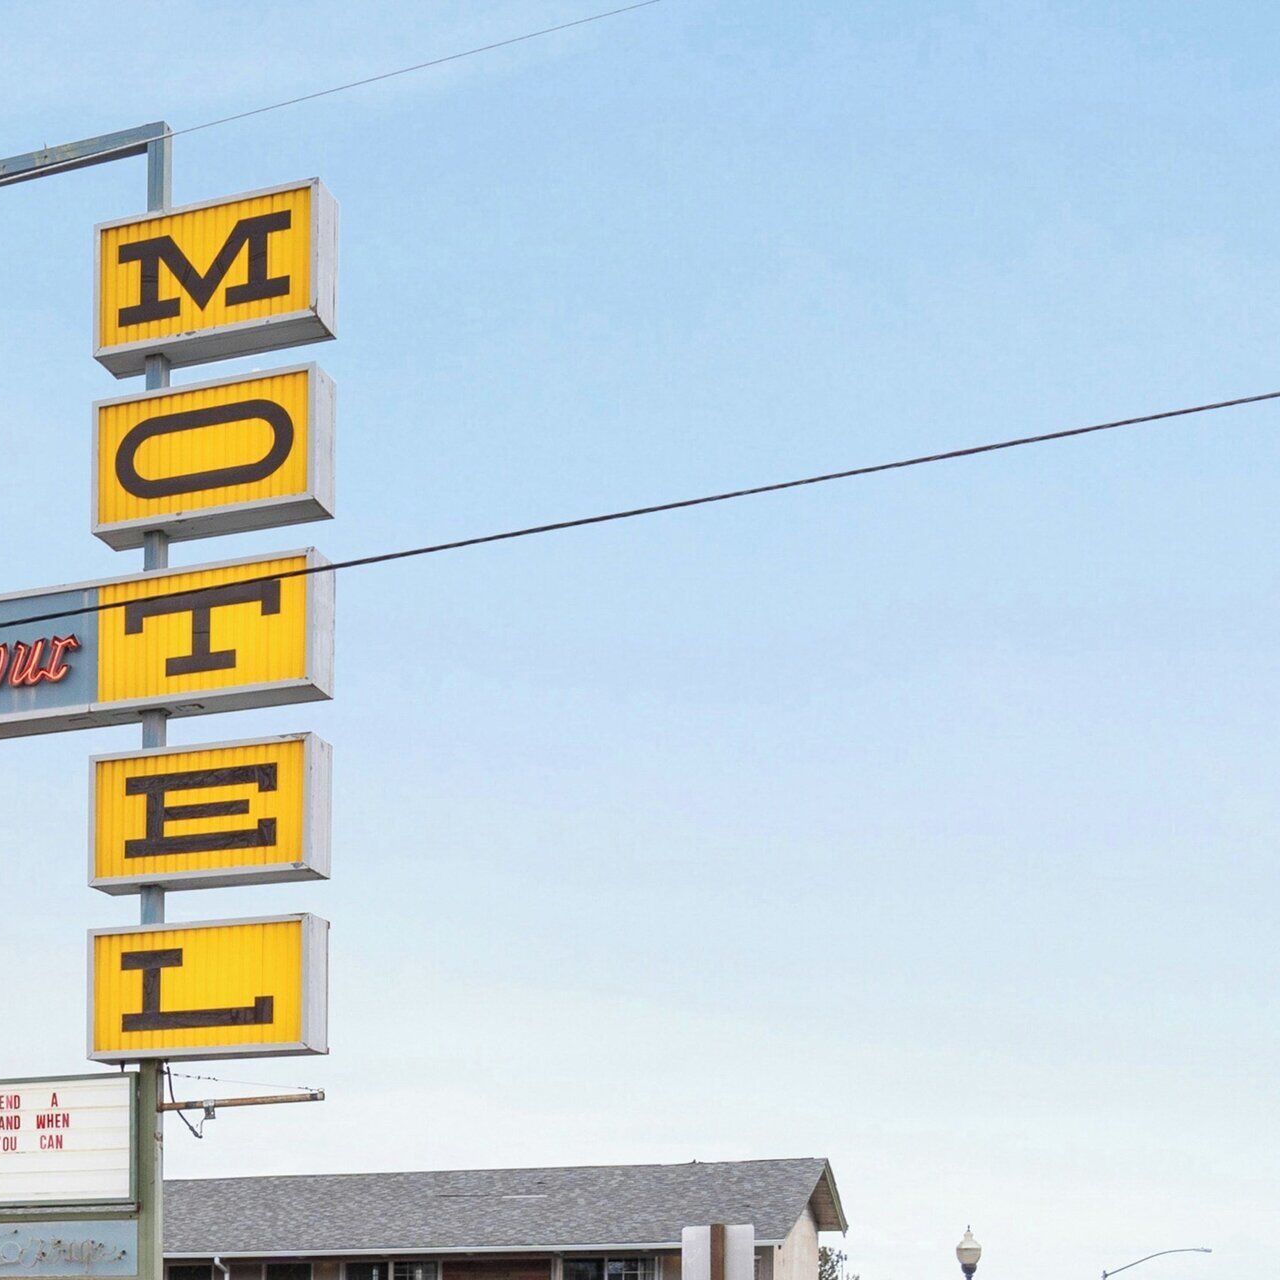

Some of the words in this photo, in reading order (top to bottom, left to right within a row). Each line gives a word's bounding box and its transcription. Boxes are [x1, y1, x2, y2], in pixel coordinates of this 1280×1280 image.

[114, 210, 294, 1033] MOTEL
[50, 1092, 58, 1108] A
[36, 1113, 70, 1129] WHEN
[39, 1134, 63, 1150] CAN
